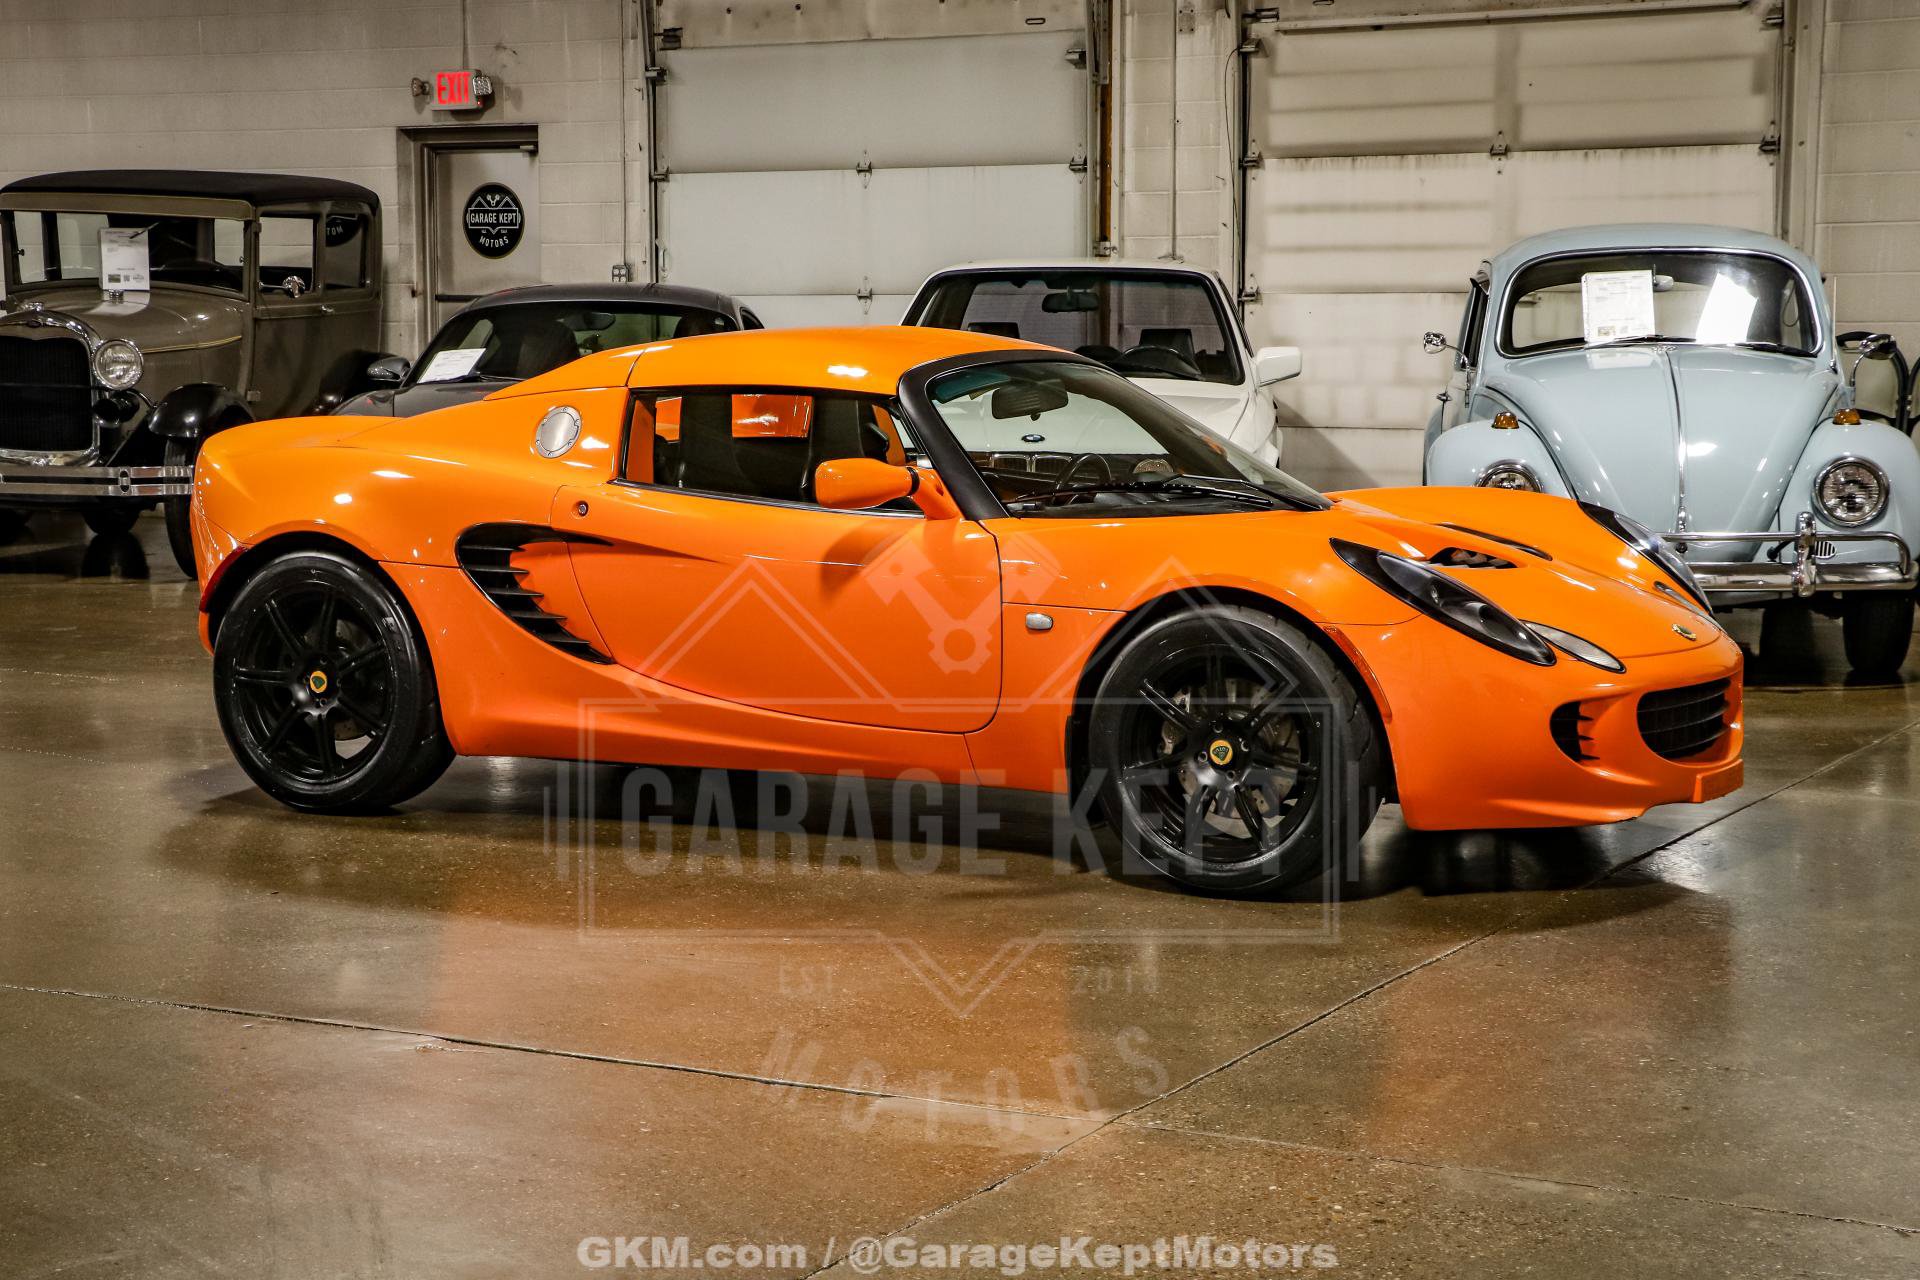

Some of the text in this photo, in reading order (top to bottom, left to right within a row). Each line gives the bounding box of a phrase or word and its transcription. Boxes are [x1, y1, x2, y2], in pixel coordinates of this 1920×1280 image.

[436, 71, 471, 104] EXIT
[470, 212, 517, 224] GARAGE KEPT
[479, 235, 509, 248] MOTORS
